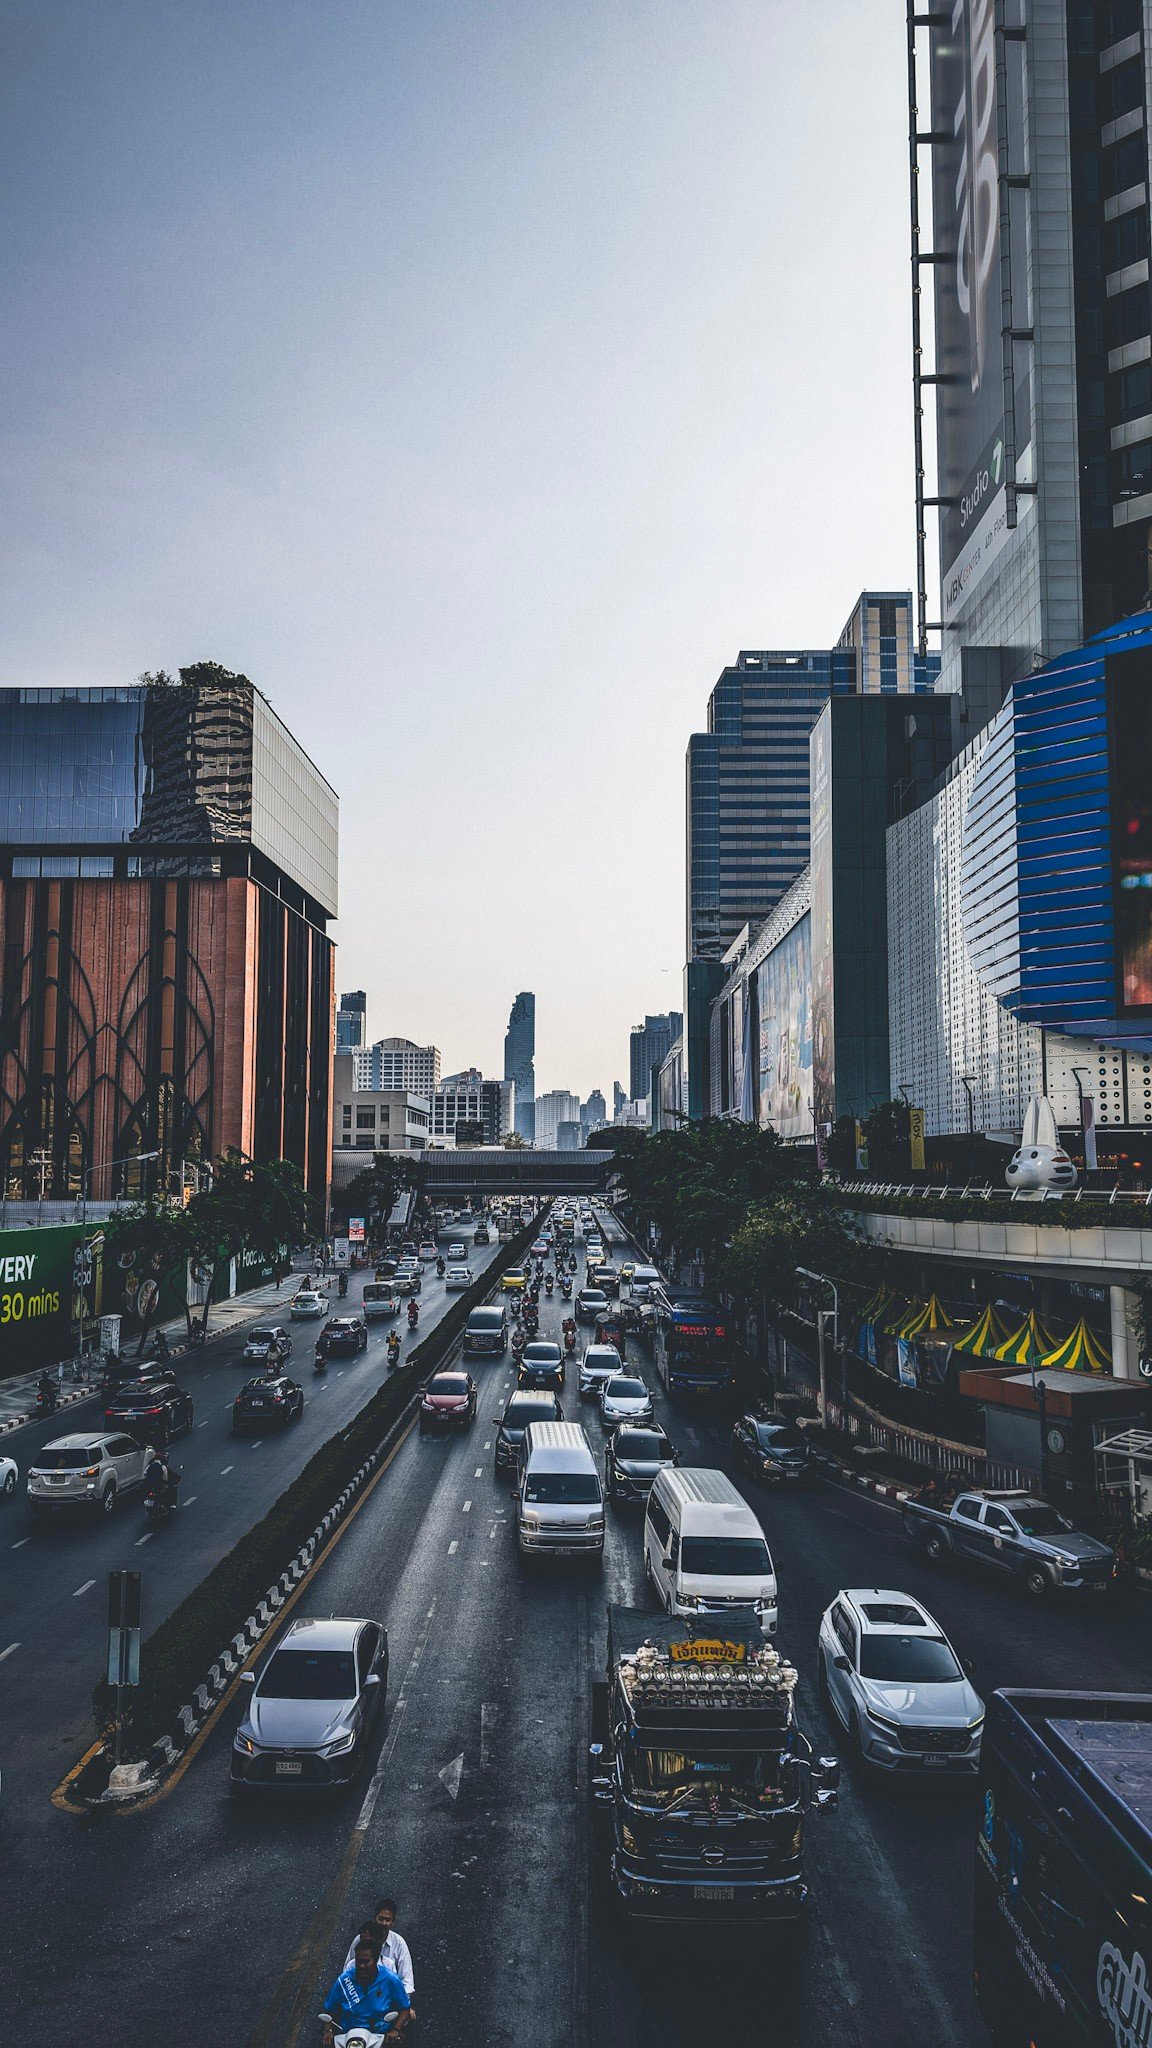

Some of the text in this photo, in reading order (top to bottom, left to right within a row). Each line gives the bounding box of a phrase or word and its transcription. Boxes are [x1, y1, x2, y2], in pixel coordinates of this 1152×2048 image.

[960, 469, 989, 528] Studio
[946, 573, 964, 613] MBK
[912, 1112, 922, 1140] max
[1, 1287, 60, 1323] 30 mins
[343, 1976, 361, 2004] RMUTP
